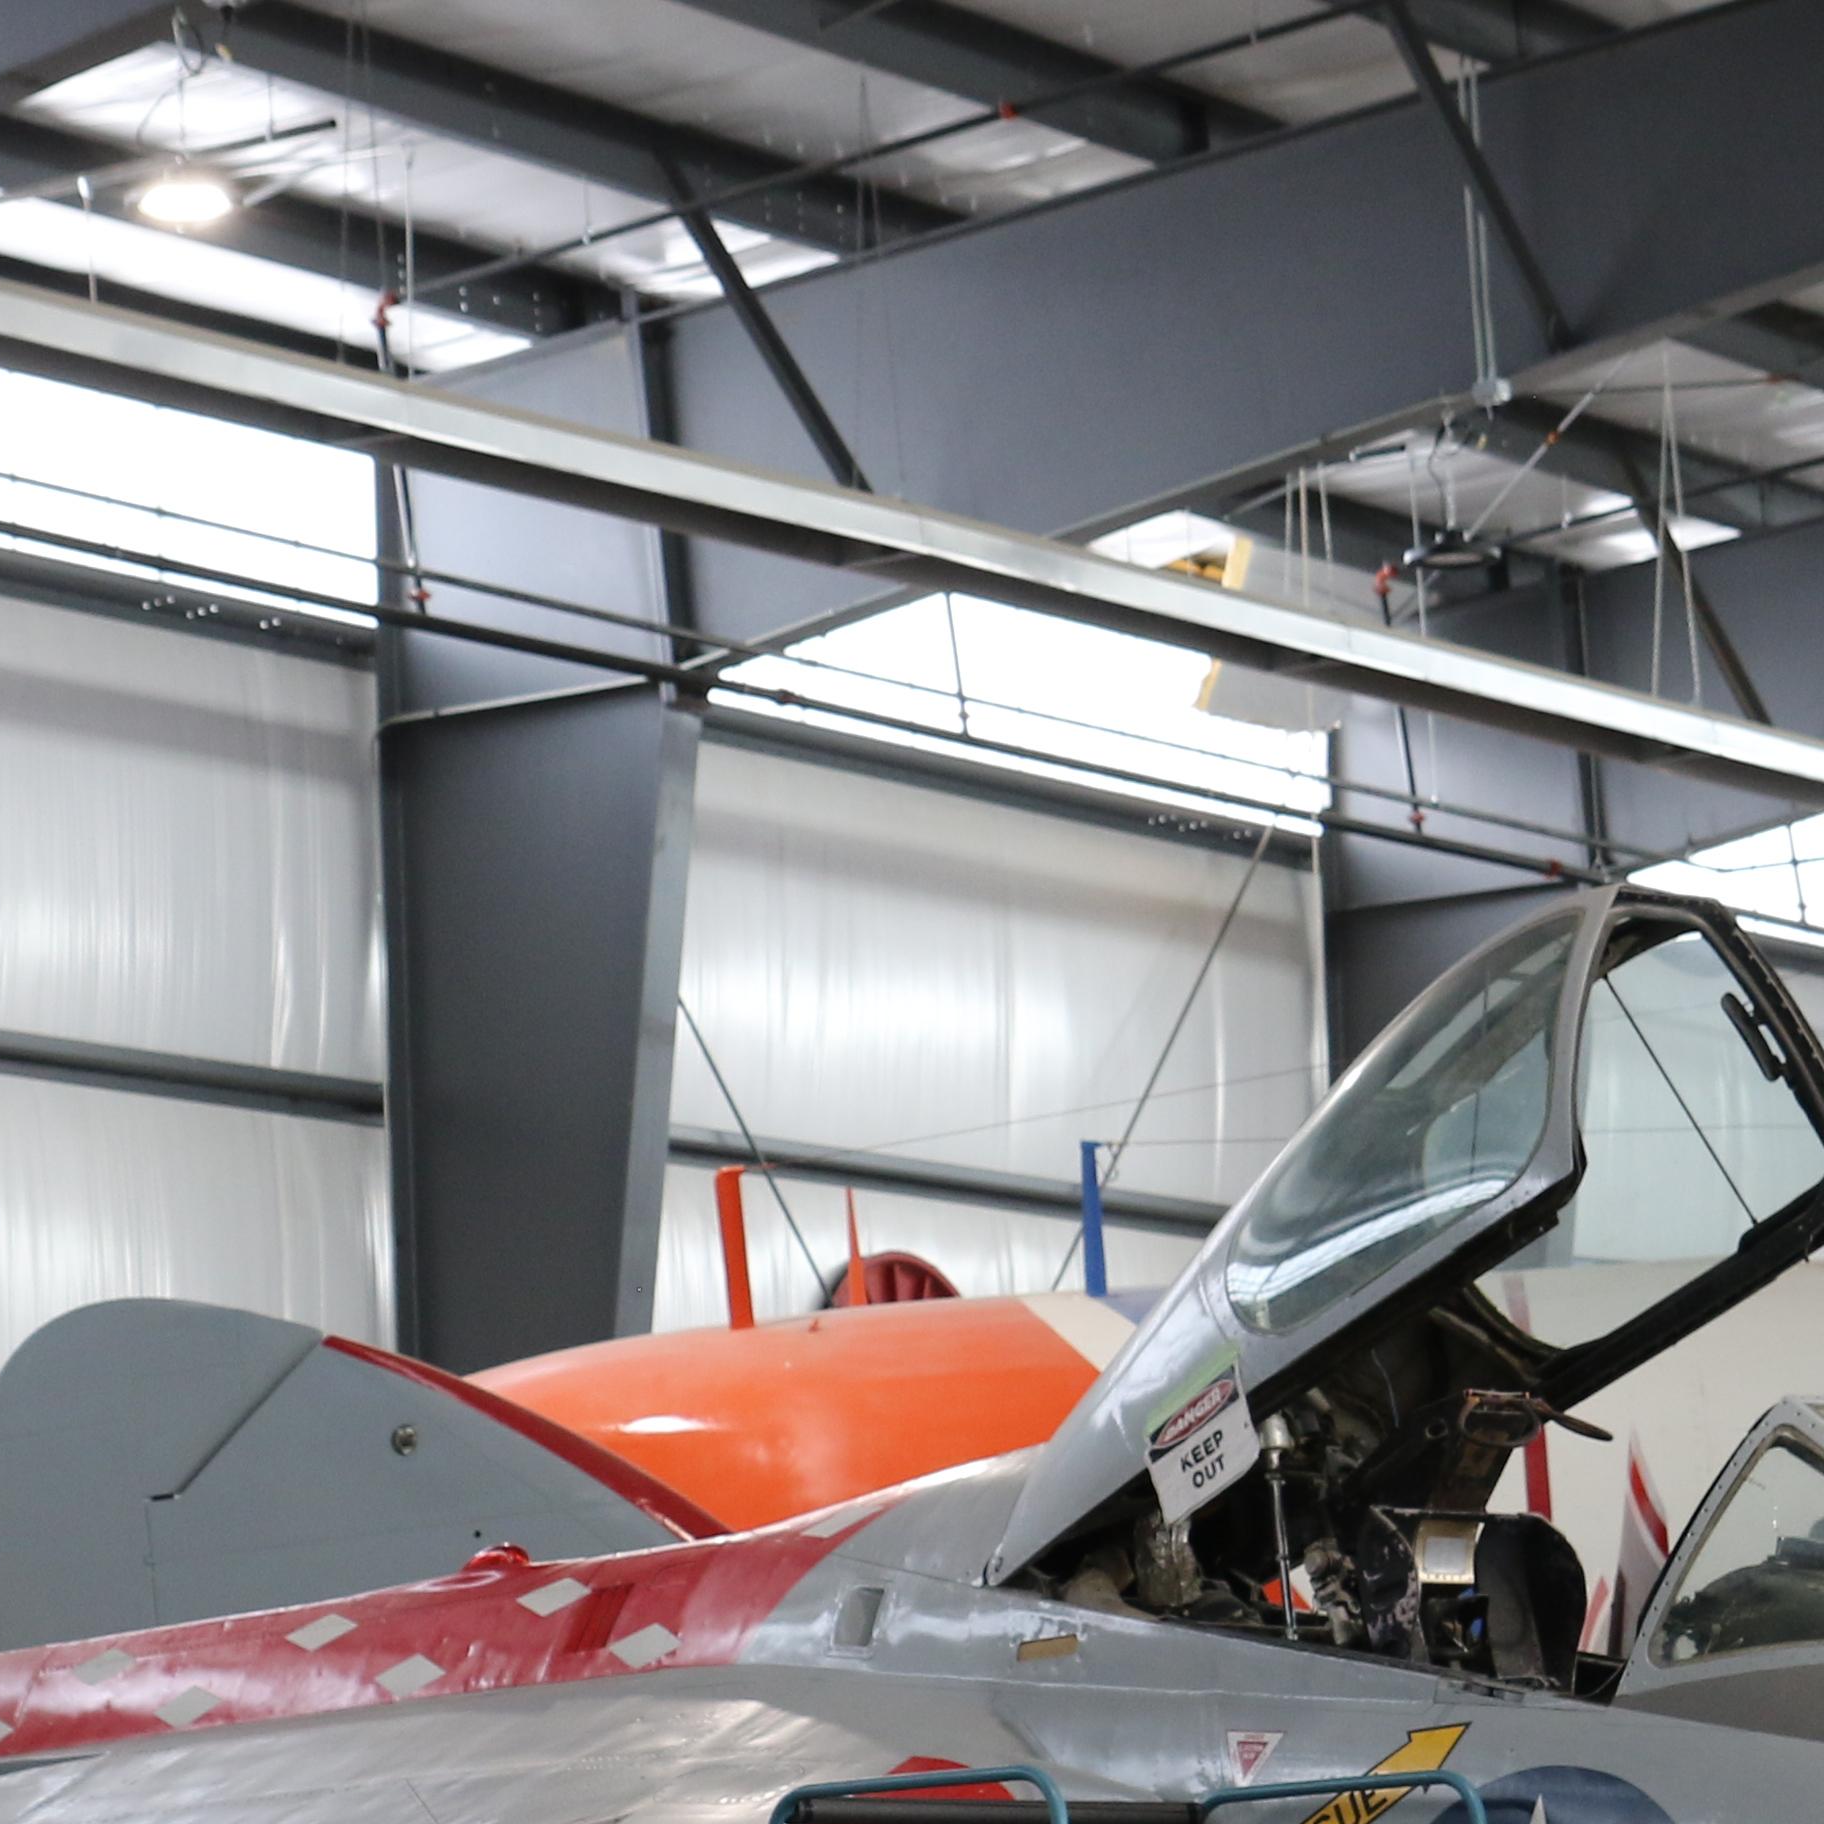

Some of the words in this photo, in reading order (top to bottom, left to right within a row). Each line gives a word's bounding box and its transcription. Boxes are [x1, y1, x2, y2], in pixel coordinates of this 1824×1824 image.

[1164, 1386, 1221, 1442] DANGER
[1180, 1429, 1223, 1473] KEEP
[1192, 1453, 1225, 1489] OUT
